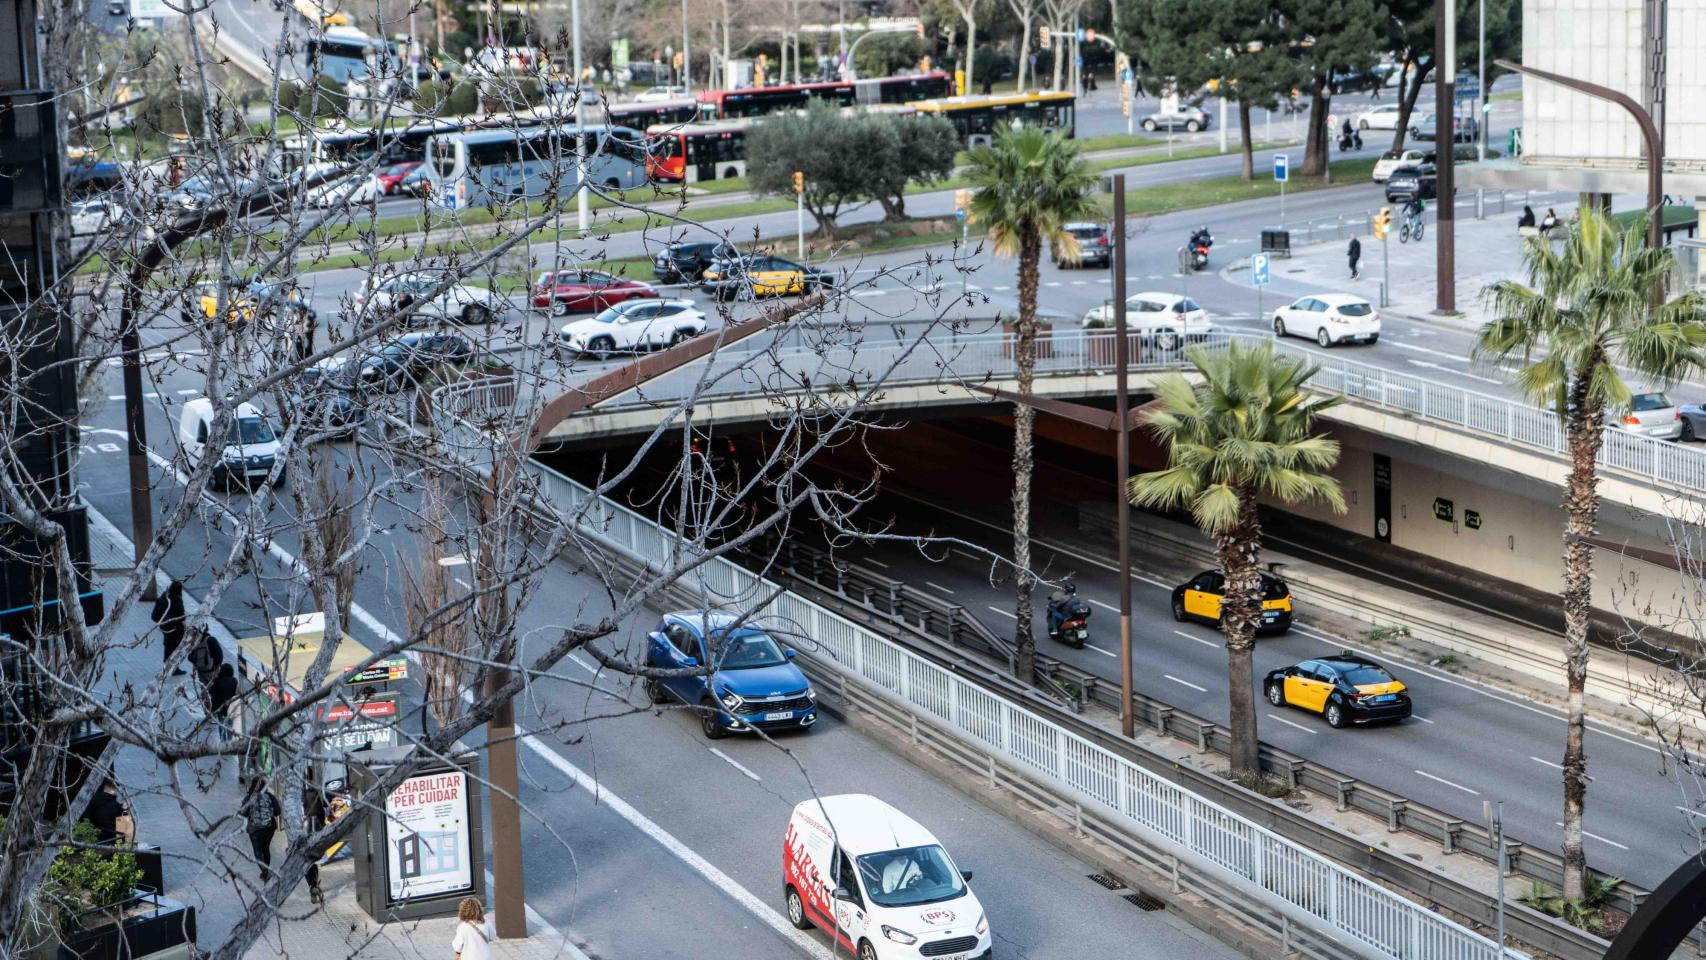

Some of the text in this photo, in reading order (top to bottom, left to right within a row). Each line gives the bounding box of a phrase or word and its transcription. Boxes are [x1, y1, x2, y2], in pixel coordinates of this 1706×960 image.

[1255, 255, 1266, 274] P
[394, 788, 458, 808] PER CUIDAR
[927, 911, 950, 920] BPS
